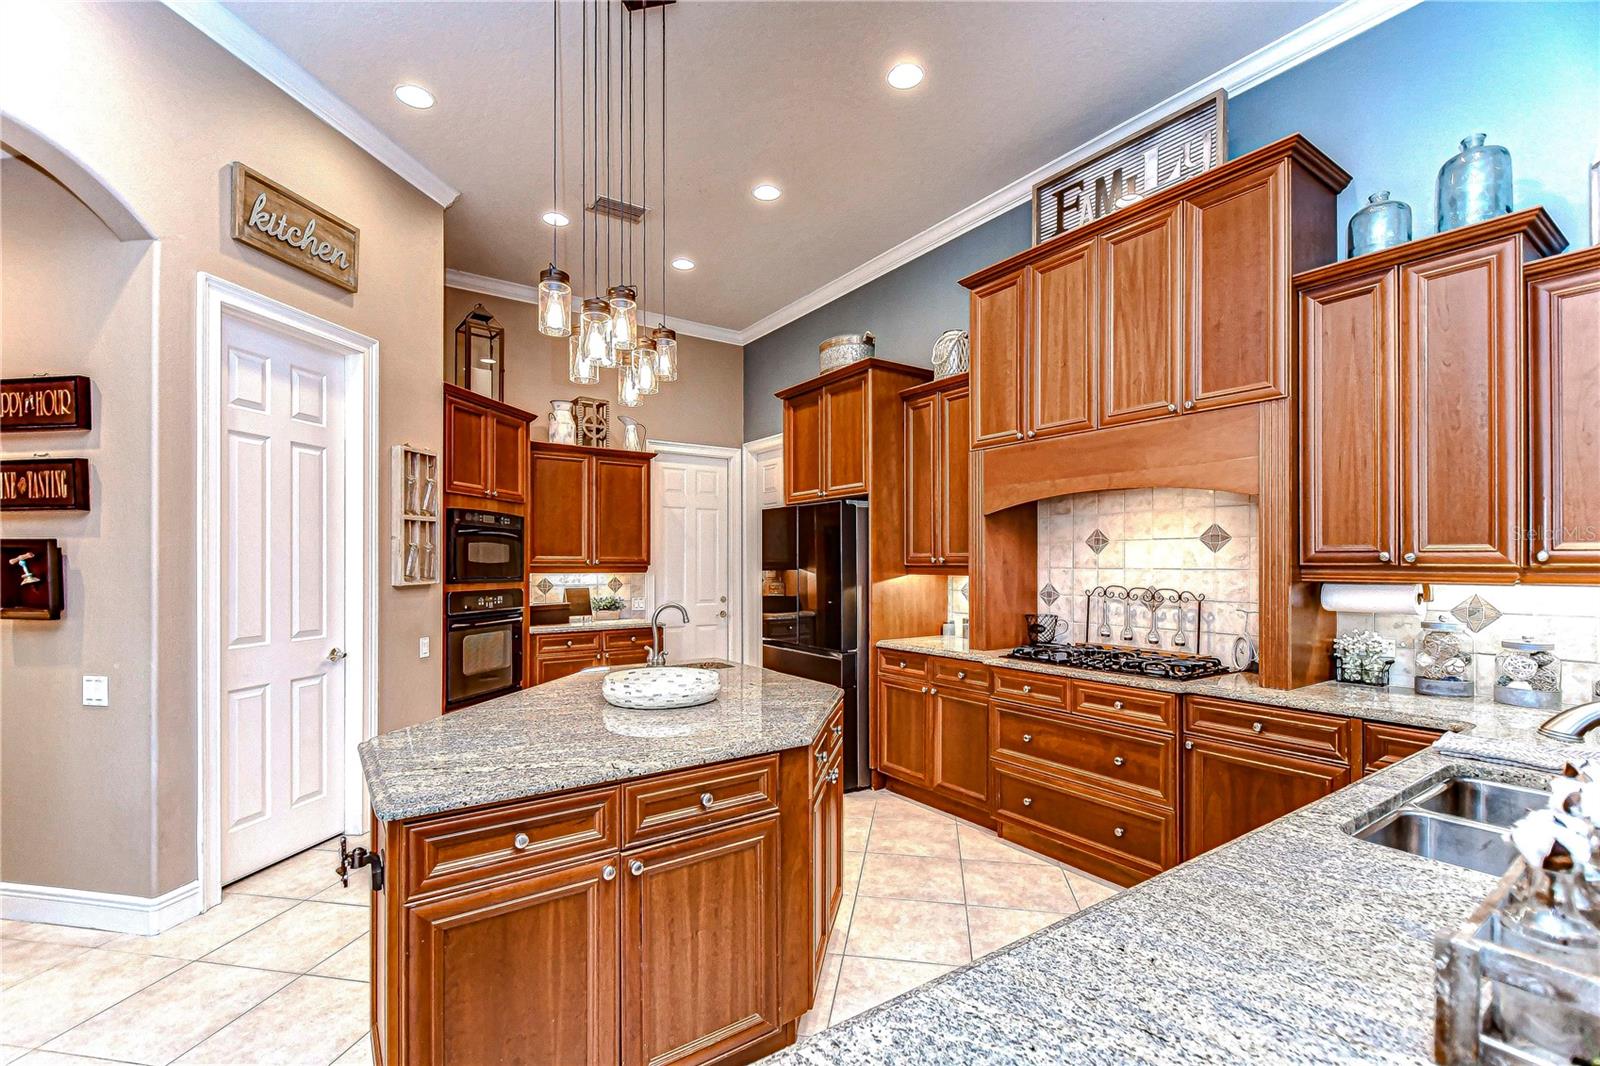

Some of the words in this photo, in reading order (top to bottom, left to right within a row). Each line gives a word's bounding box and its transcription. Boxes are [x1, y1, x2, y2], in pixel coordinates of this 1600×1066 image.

[248, 192, 350, 270] kitchen
[0, 391, 24, 417] PPY
[35, 389, 71, 416] HOUR
[0, 471, 17, 499] INE
[26, 469, 68, 499] TASTING
